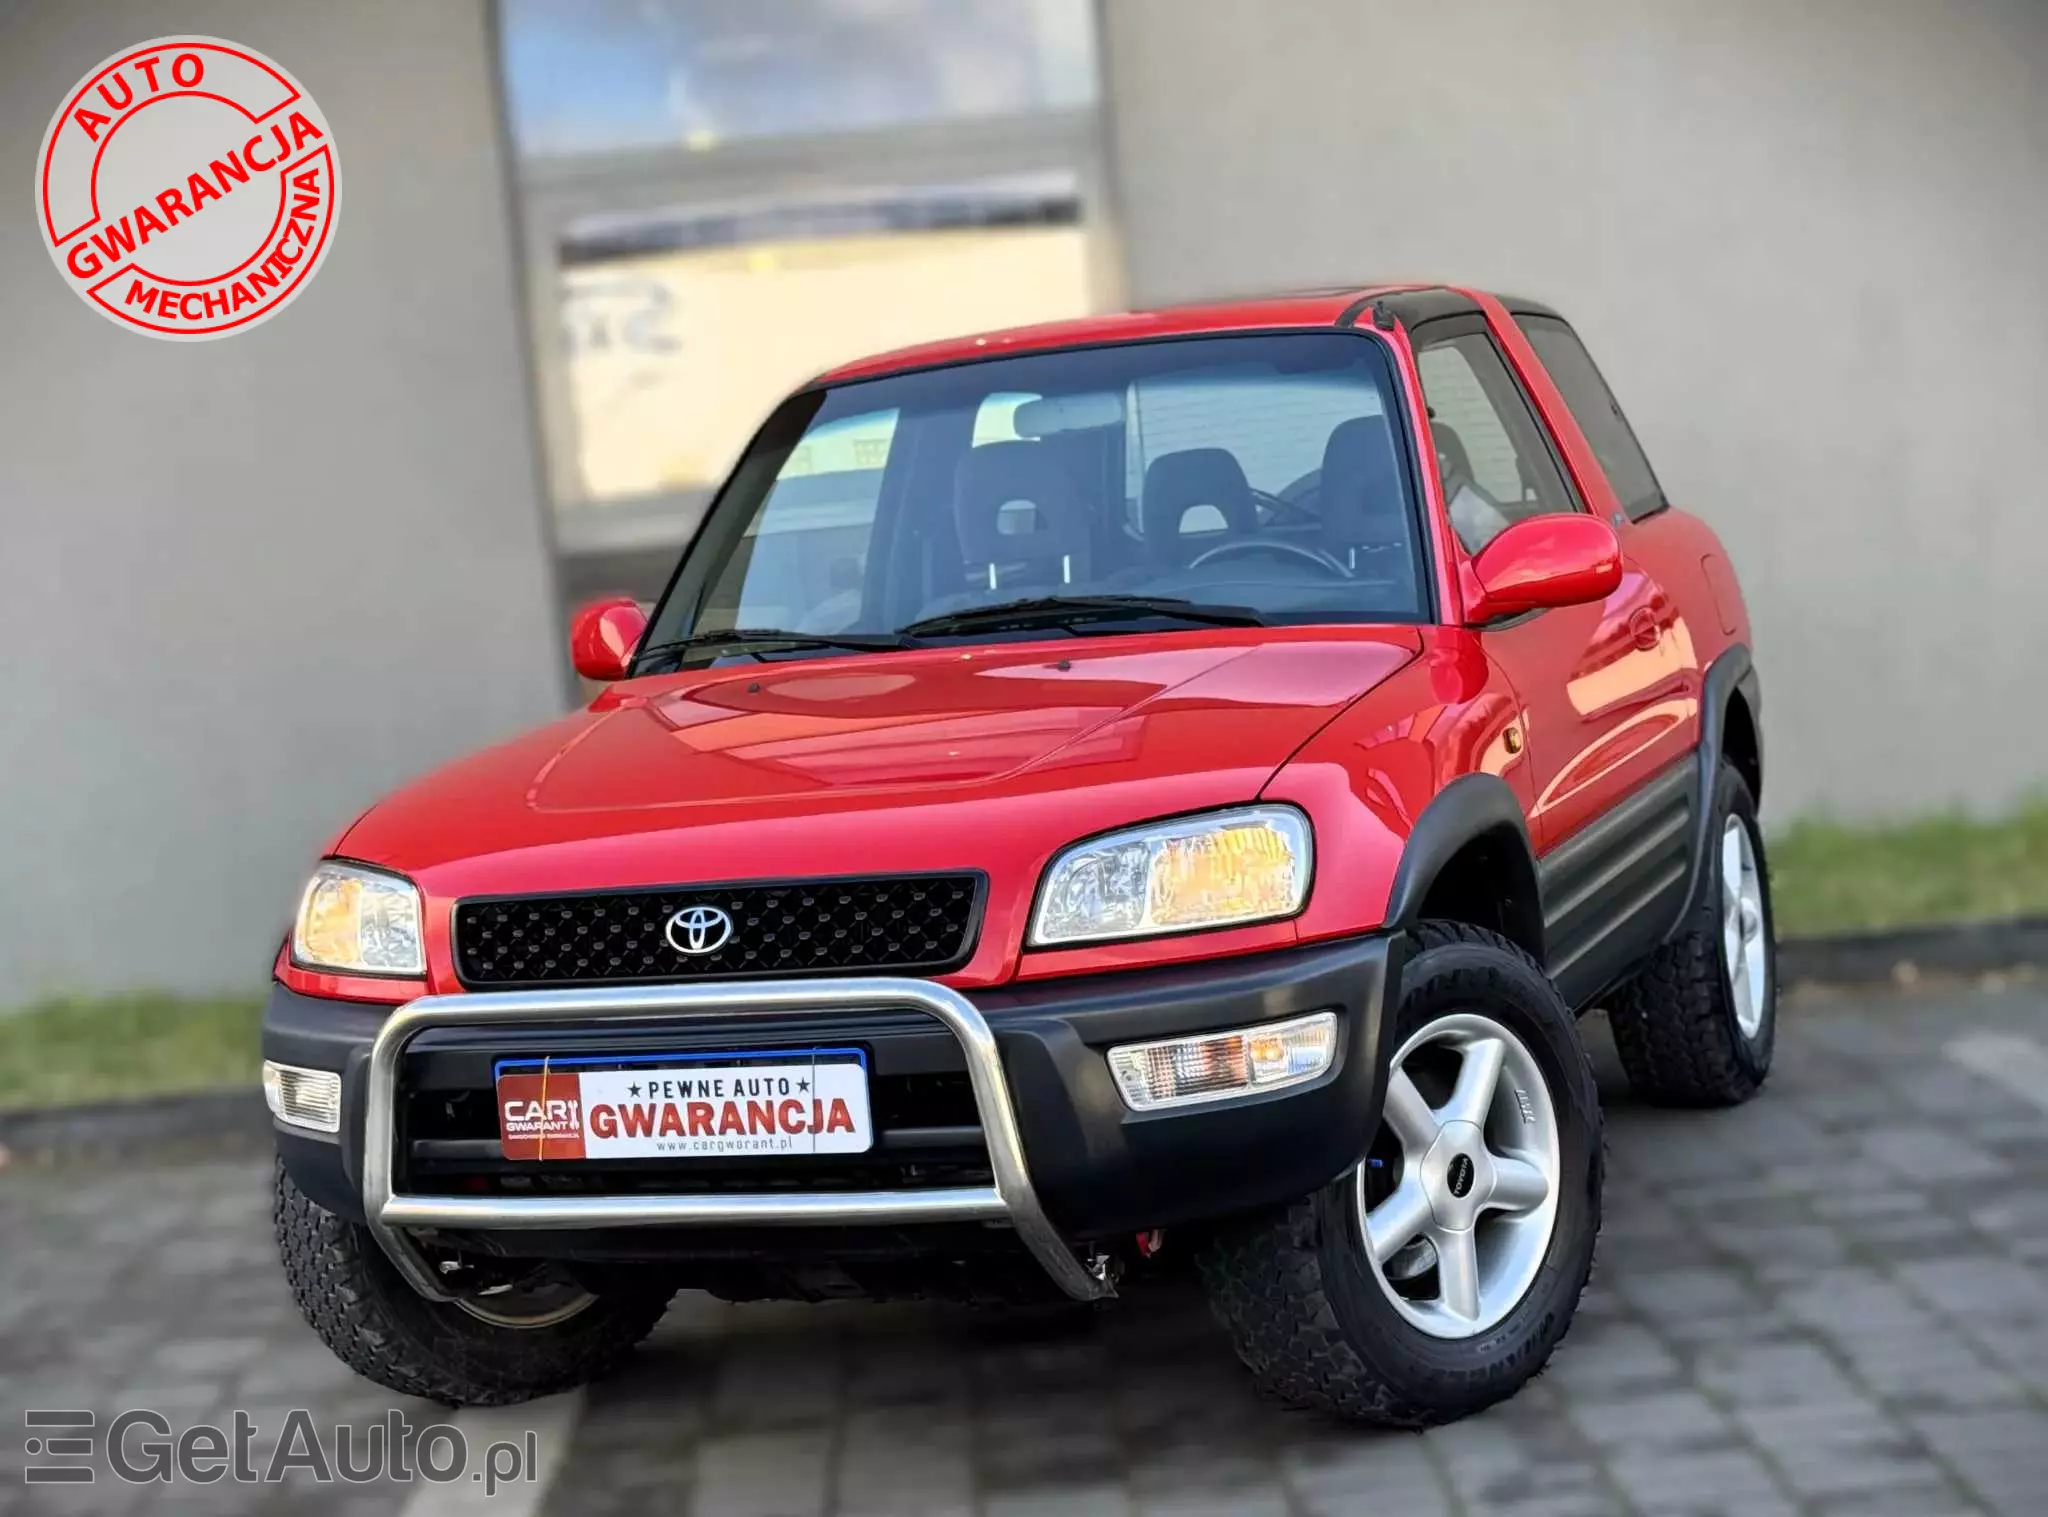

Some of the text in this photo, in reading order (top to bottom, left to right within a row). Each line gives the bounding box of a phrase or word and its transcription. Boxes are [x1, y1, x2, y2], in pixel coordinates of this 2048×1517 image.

[648, 1078, 790, 1099] PEWNE AUTO
[504, 1100, 568, 1121] CAR
[589, 1098, 856, 1139] GWARANCJA
[656, 1136, 792, 1153] www.cargwarant.pl
